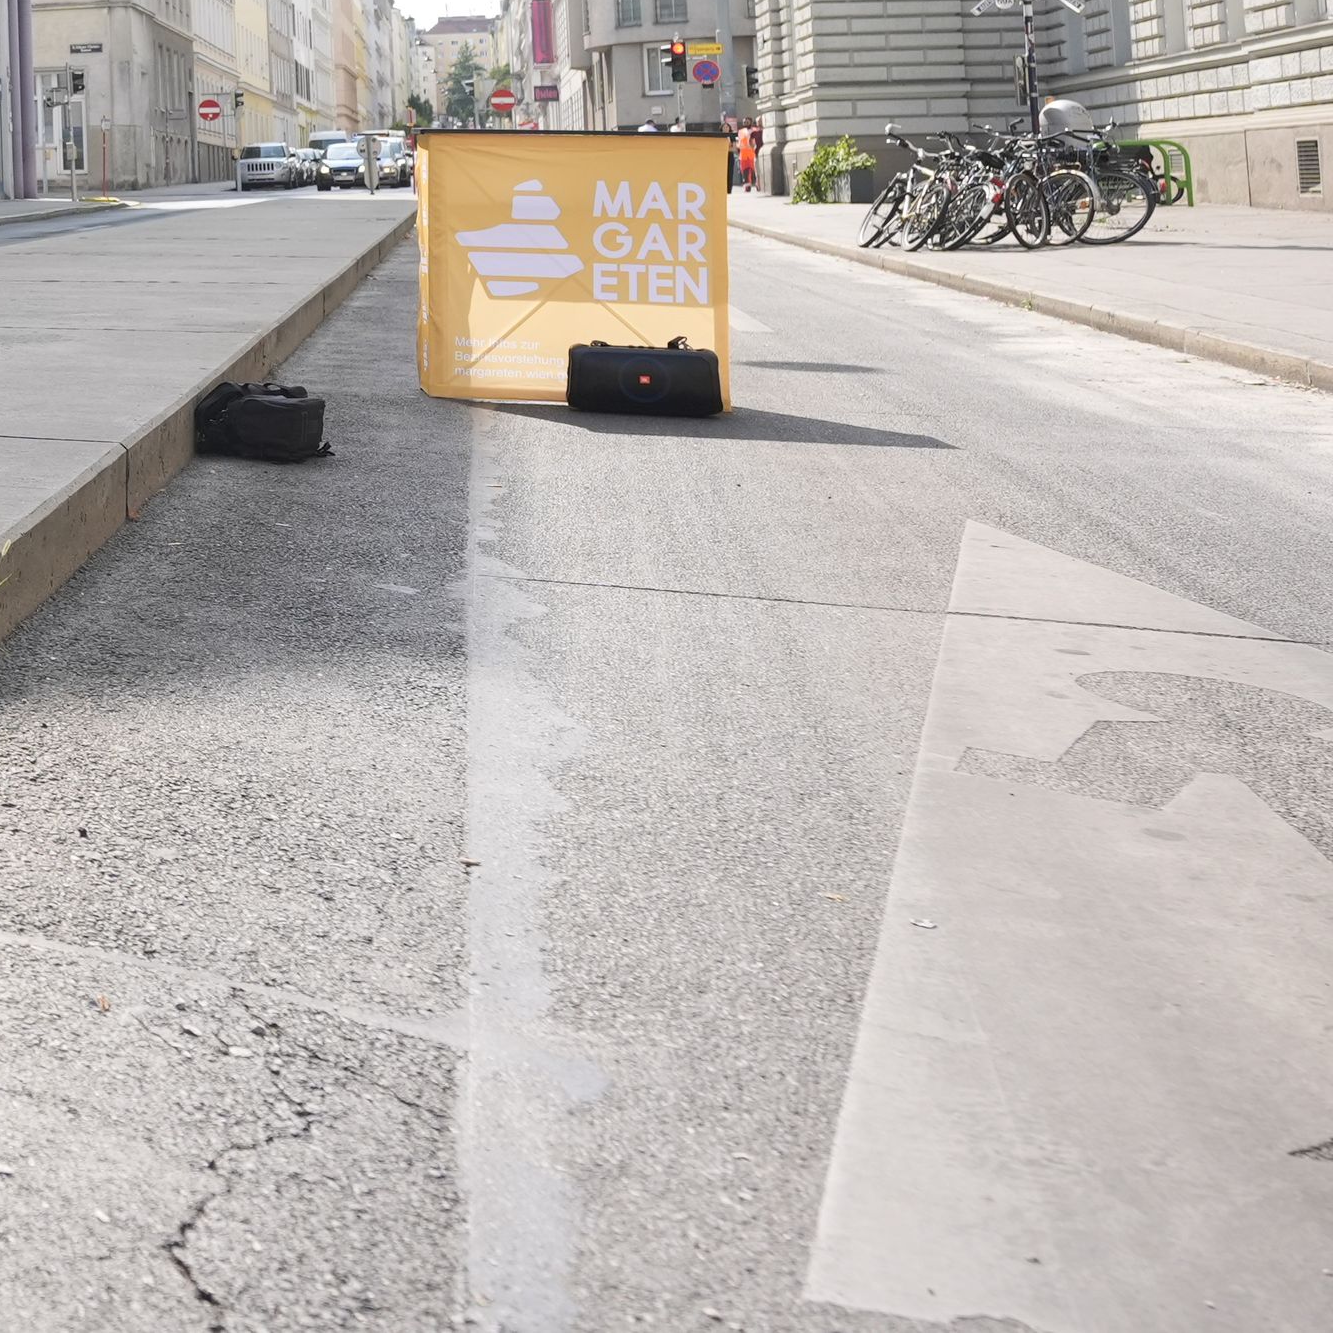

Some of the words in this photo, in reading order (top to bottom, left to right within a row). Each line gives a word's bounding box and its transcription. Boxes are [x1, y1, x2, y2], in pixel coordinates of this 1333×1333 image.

[593, 180, 706, 221] MAR
[593, 221, 707, 262] GAR
[593, 263, 708, 305] ETEN
[455, 337, 486, 347] Mehr
